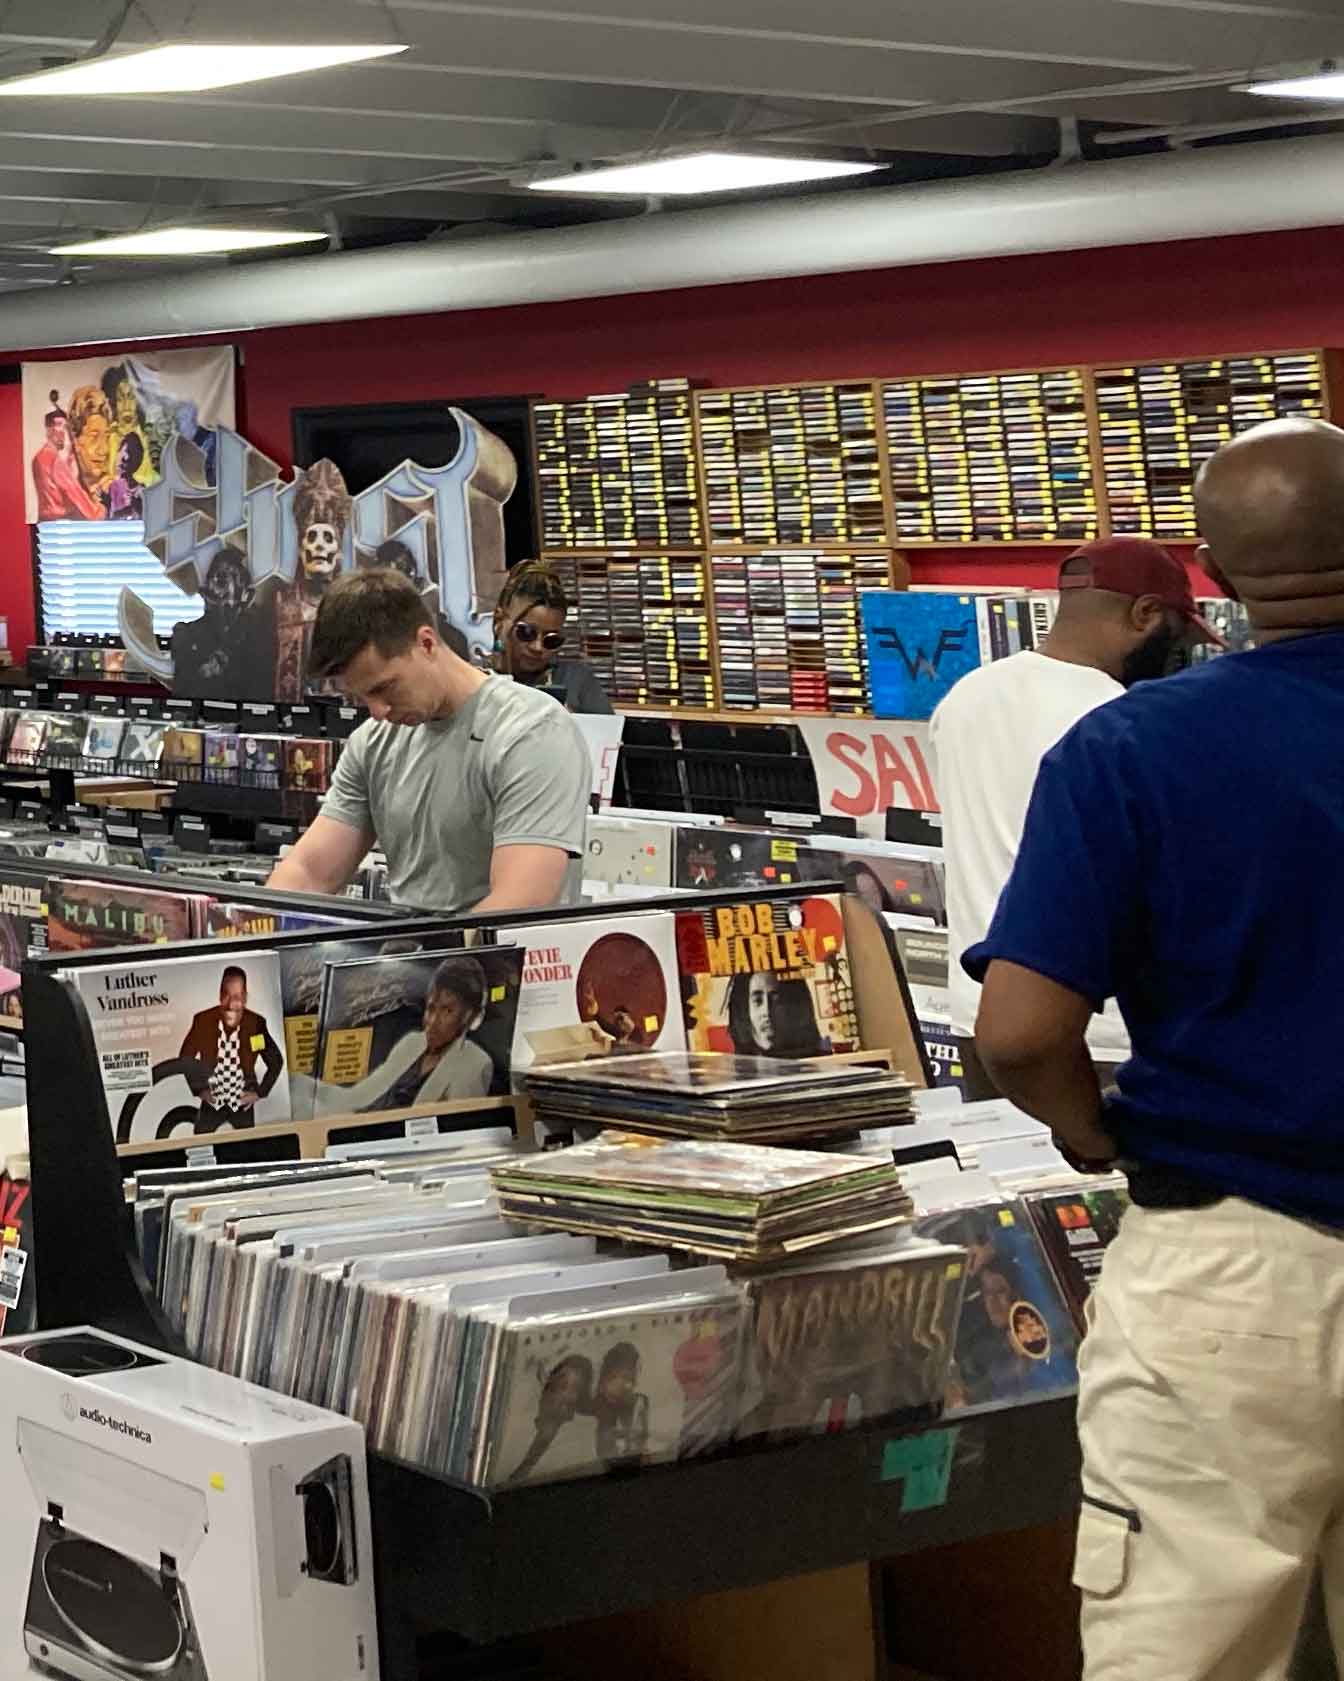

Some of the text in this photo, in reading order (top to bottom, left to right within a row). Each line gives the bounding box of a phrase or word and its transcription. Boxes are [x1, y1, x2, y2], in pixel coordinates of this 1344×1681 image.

[825, 731, 943, 817] SAL
[64, 903, 164, 932] MALIBU
[716, 902, 774, 937] BOB
[523, 946, 561, 966] EVIE
[706, 927, 818, 976] MARLEY
[104, 972, 157, 991] Luther
[523, 964, 574, 984] ONDER
[96, 992, 169, 1011] Vandross
[79, 1404, 153, 1444] audio-technica
